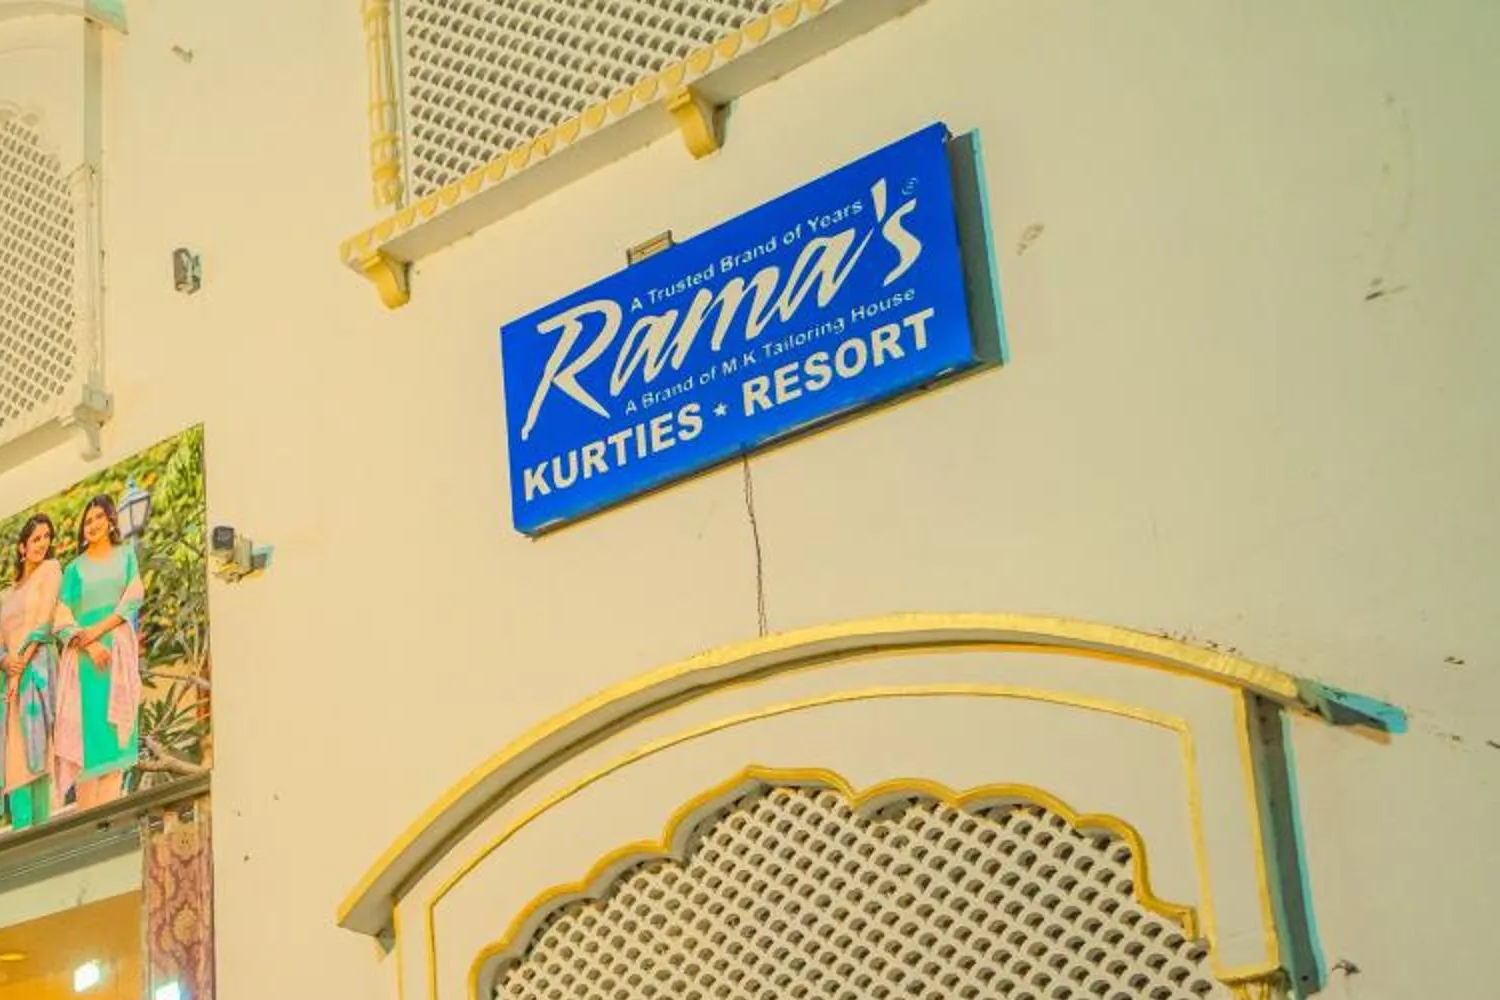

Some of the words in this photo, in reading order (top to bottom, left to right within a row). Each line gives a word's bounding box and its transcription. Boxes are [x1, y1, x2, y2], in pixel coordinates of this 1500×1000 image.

[520, 177, 923, 441] Rama's
[630, 297, 643, 313] A
[647, 264, 715, 304] Trusted
[719, 241, 778, 274] Brand
[782, 224, 801, 246] of
[806, 200, 864, 233] Years
[523, 402, 704, 504] KURTIES
[741, 307, 935, 418] RESORT
[624, 399, 637, 416] A
[641, 376, 694, 409] Brand
[699, 366, 717, 386] of
[762, 316, 846, 359] Tailoring
[850, 287, 916, 323] House
